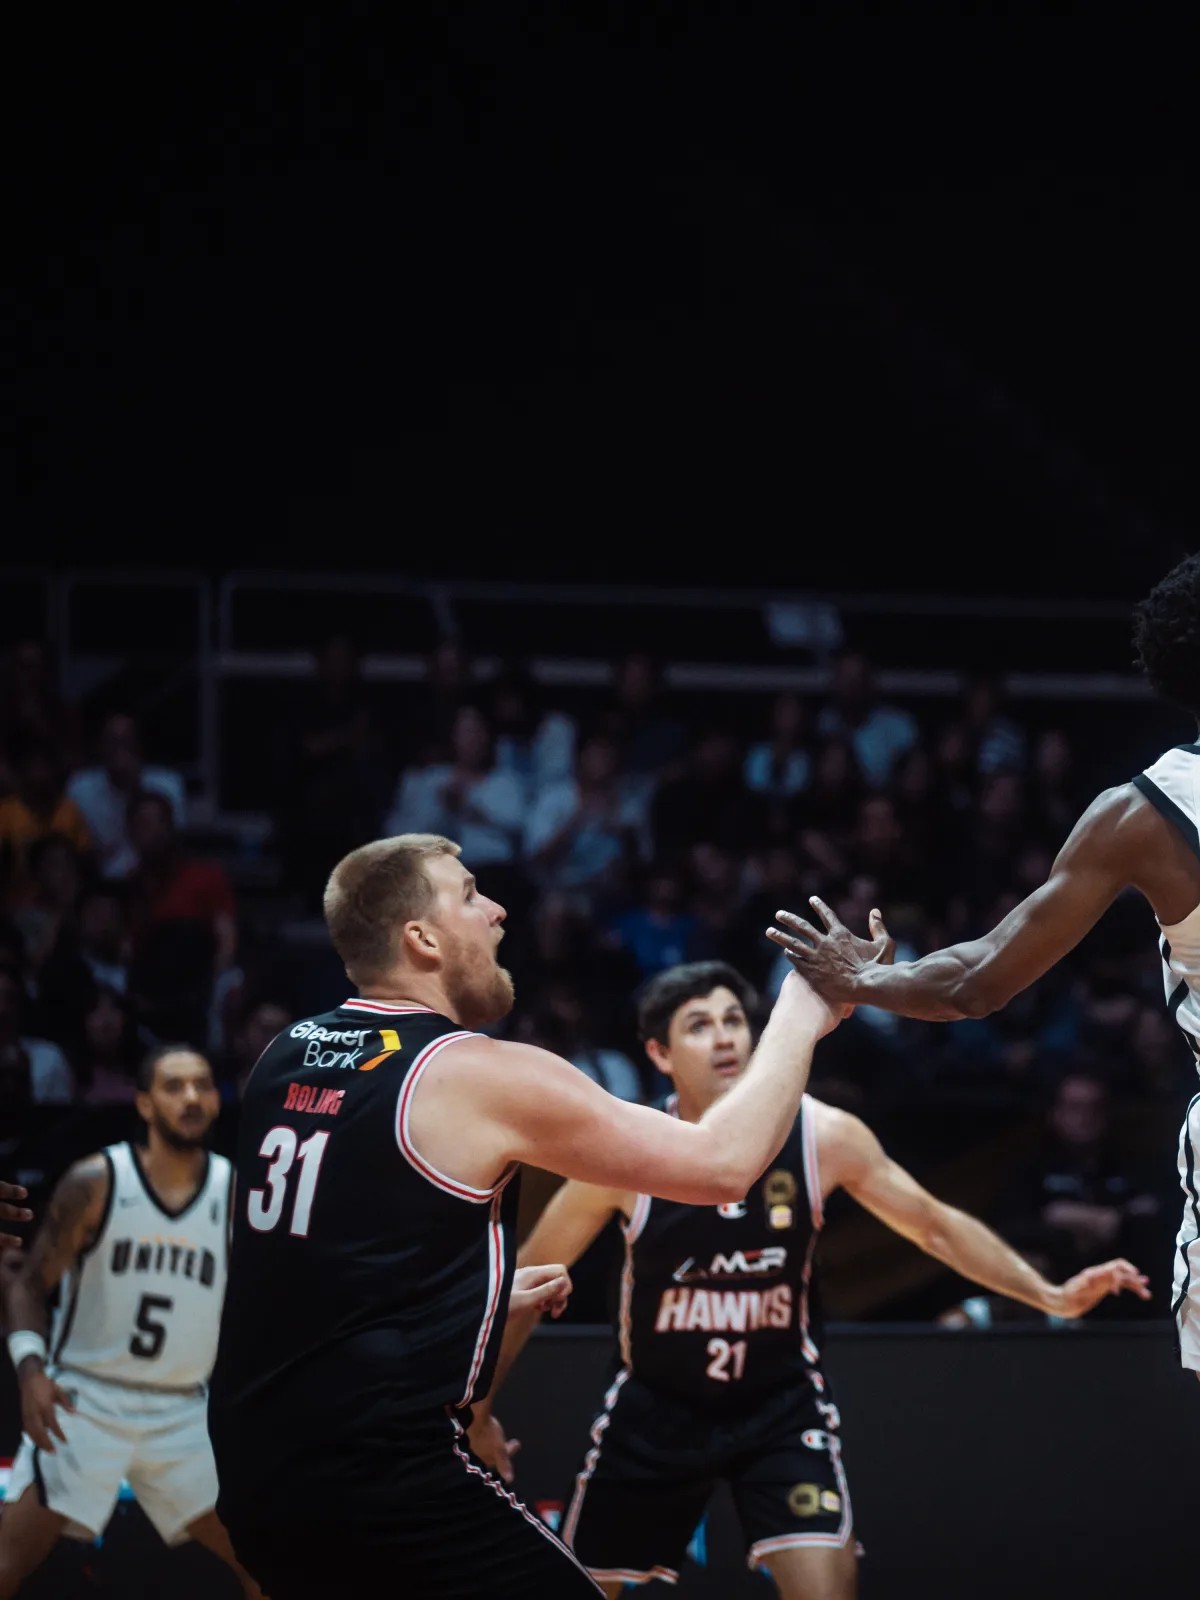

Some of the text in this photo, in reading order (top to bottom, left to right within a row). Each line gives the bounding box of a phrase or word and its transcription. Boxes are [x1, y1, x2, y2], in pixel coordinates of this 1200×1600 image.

[302, 1040, 363, 1070] Bank
[247, 1124, 332, 1238] 31
[110, 1237, 217, 1290] UNITED
[128, 1291, 173, 1363] 5
[654, 1283, 793, 1335] HAWKS
[705, 1337, 748, 1383] 21
